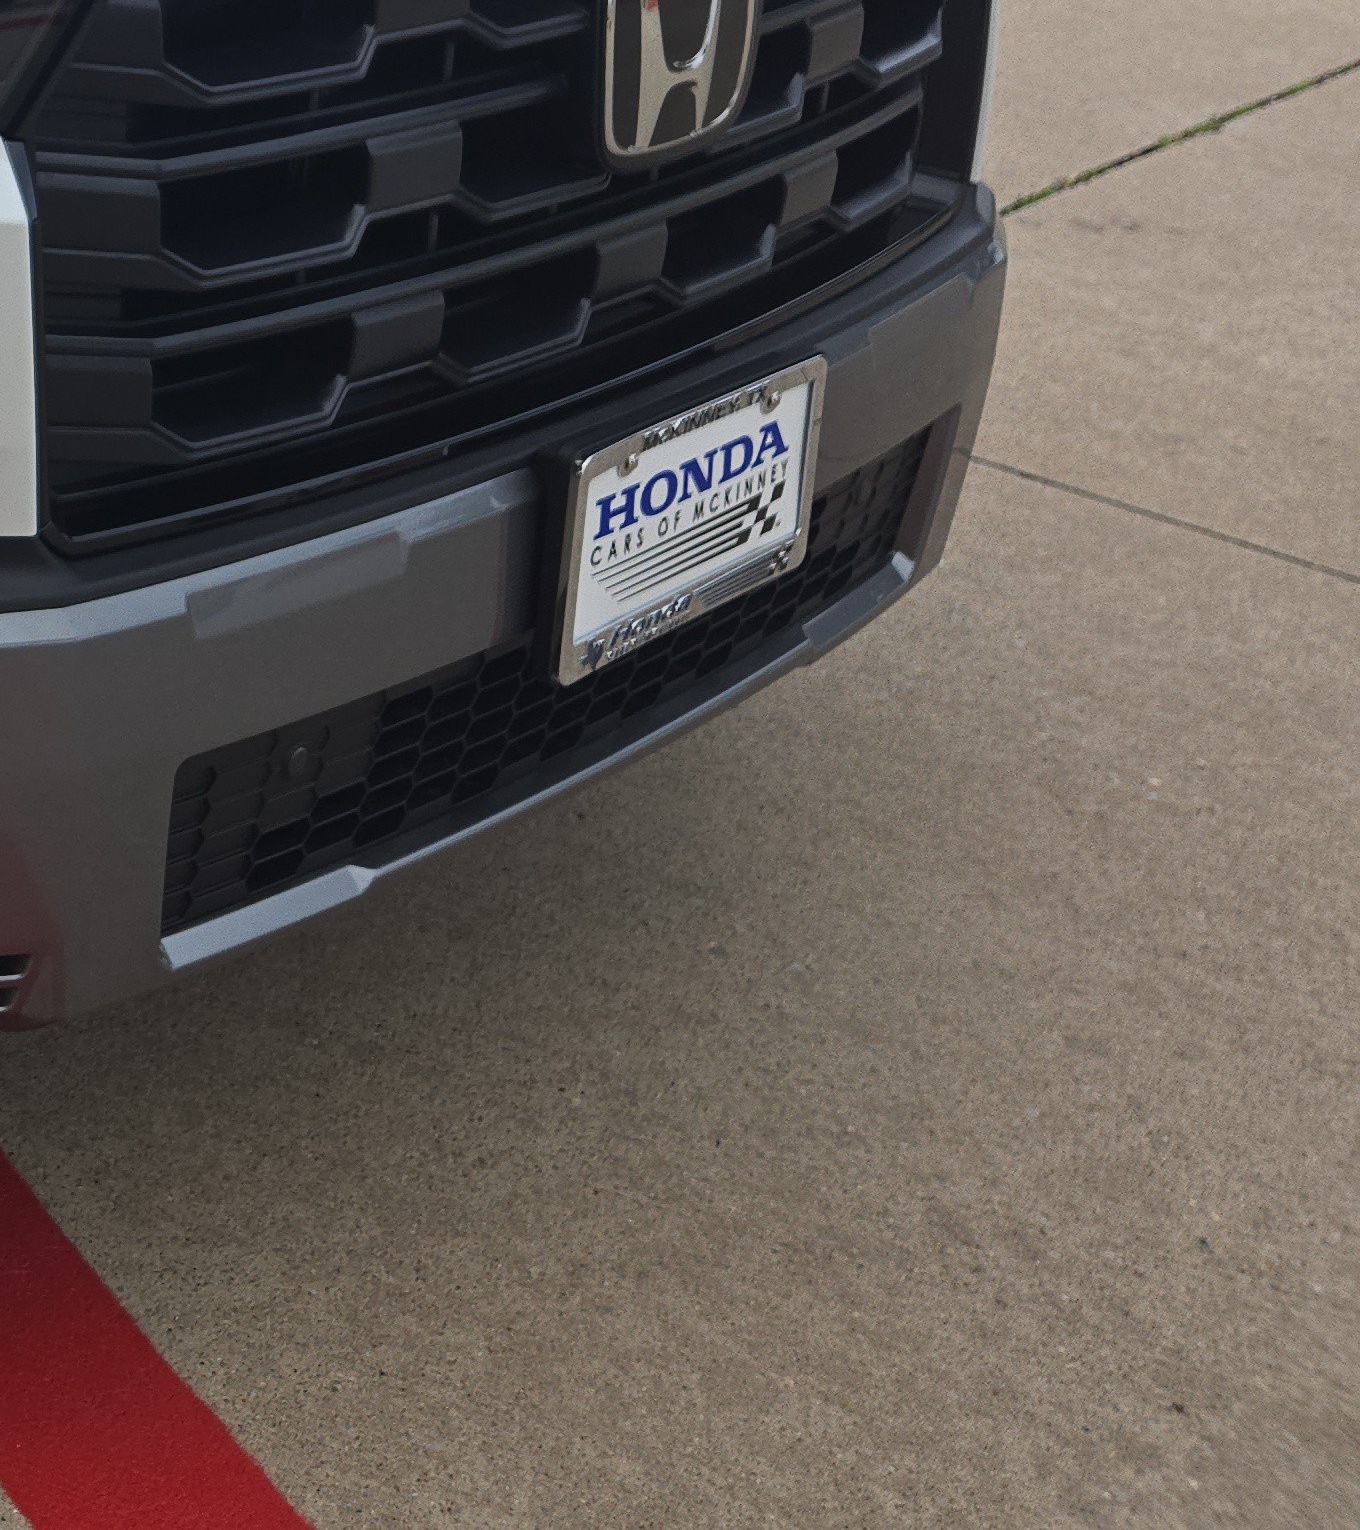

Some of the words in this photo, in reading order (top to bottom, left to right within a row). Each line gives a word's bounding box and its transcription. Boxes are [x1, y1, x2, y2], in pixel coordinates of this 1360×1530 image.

[590, 527, 644, 566] CARS
[658, 509, 682, 537] OF
[692, 459, 790, 525] MCKINNEY
[593, 420, 789, 541] HONDA
